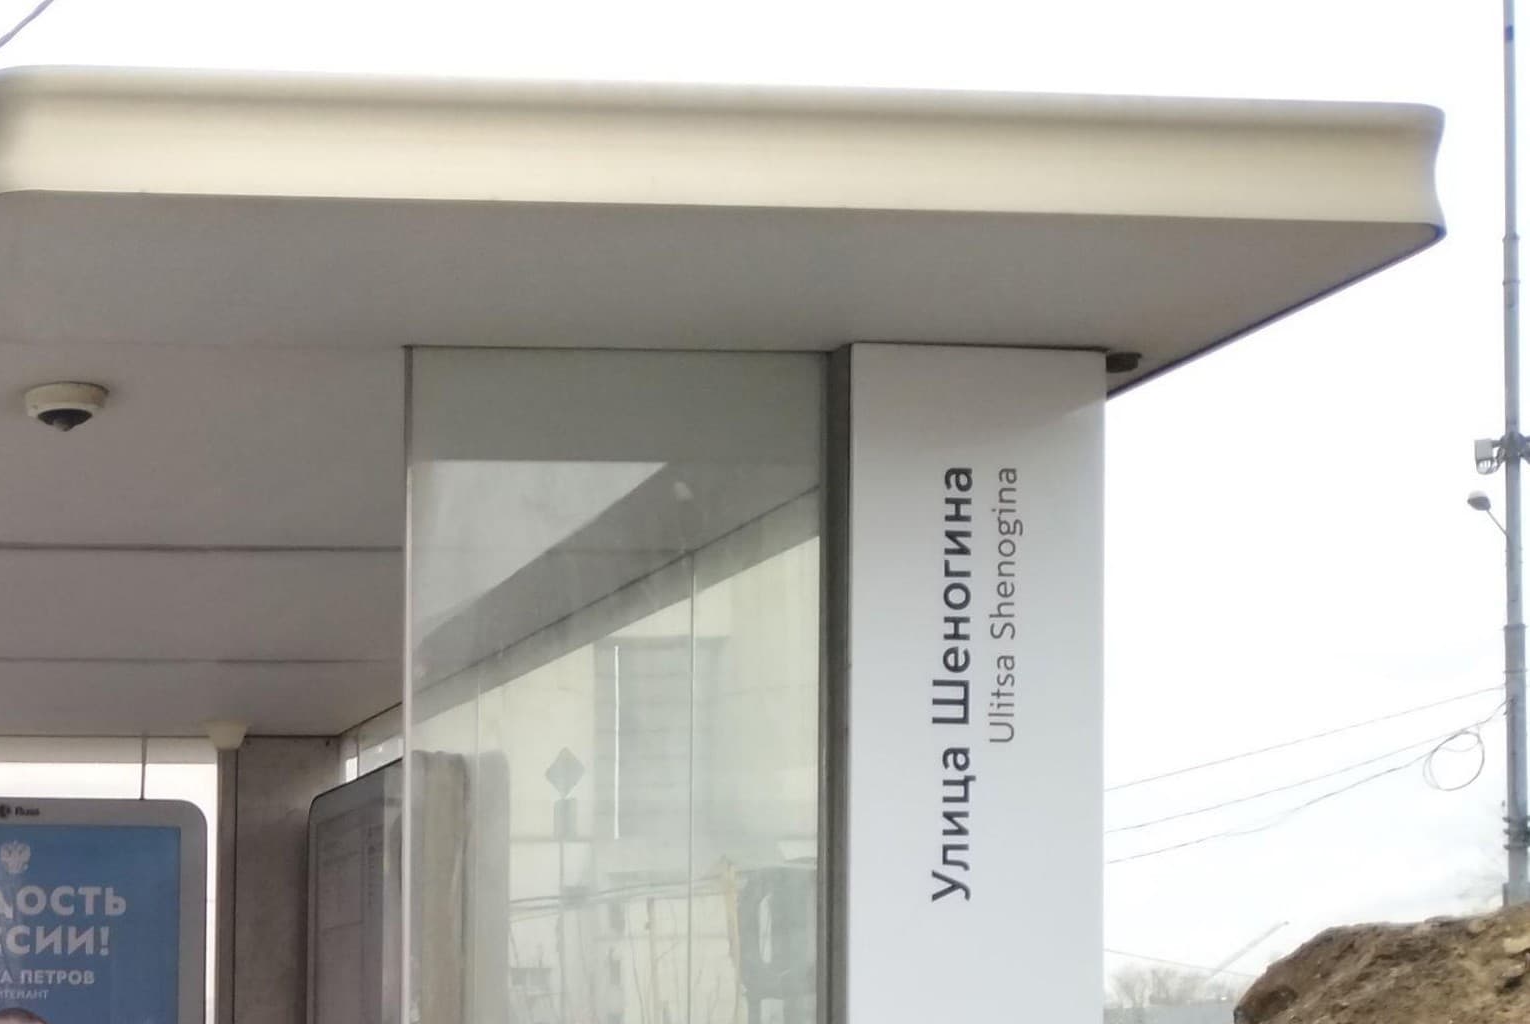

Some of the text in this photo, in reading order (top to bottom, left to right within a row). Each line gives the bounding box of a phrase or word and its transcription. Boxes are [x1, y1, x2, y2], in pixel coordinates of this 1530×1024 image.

[931, 467, 977, 901] Улица Шеногина
[988, 467, 1023, 743] Ulitsa Shenogina
[20, 969, 95, 985] ПЕТРОВ
